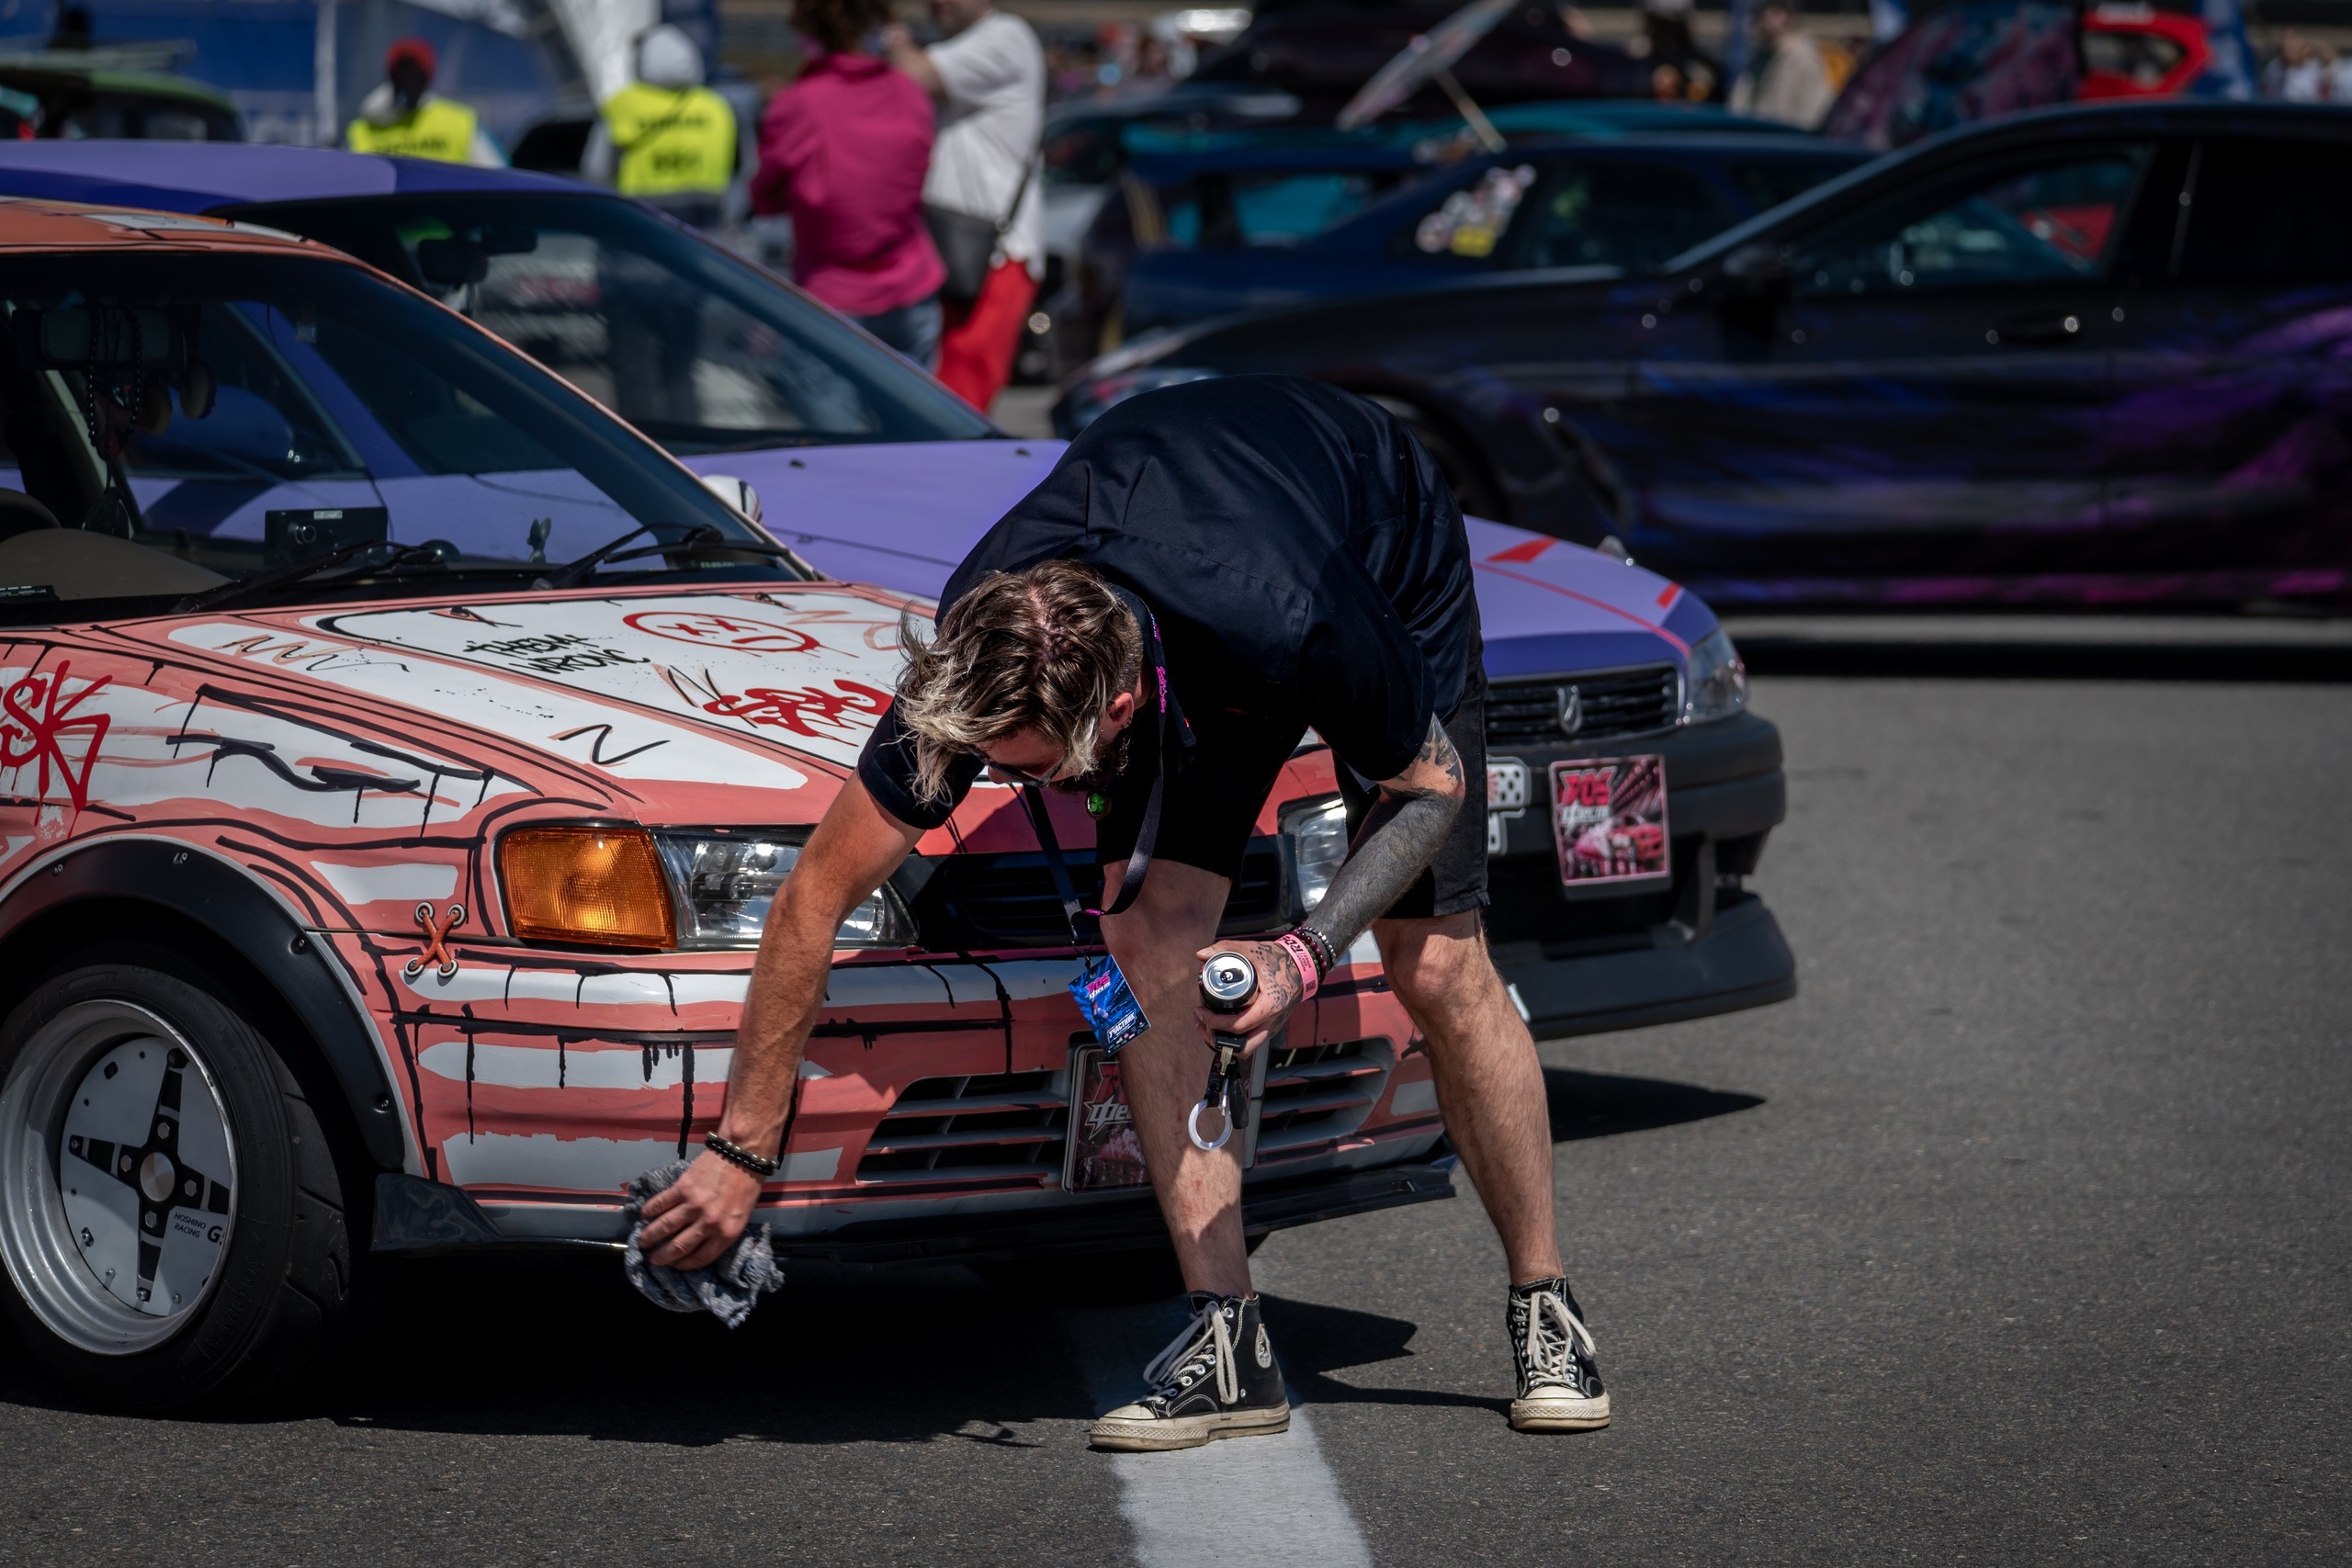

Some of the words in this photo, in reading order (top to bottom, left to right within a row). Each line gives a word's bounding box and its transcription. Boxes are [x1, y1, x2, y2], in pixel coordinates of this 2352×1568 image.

[1561, 767, 1615, 806] RDS
[1085, 970, 1111, 994] RDS
[1109, 1011, 1136, 1039] УЧАСТНИК
[174, 1213, 207, 1230] HOSHINO
[174, 1223, 201, 1238] RACING
